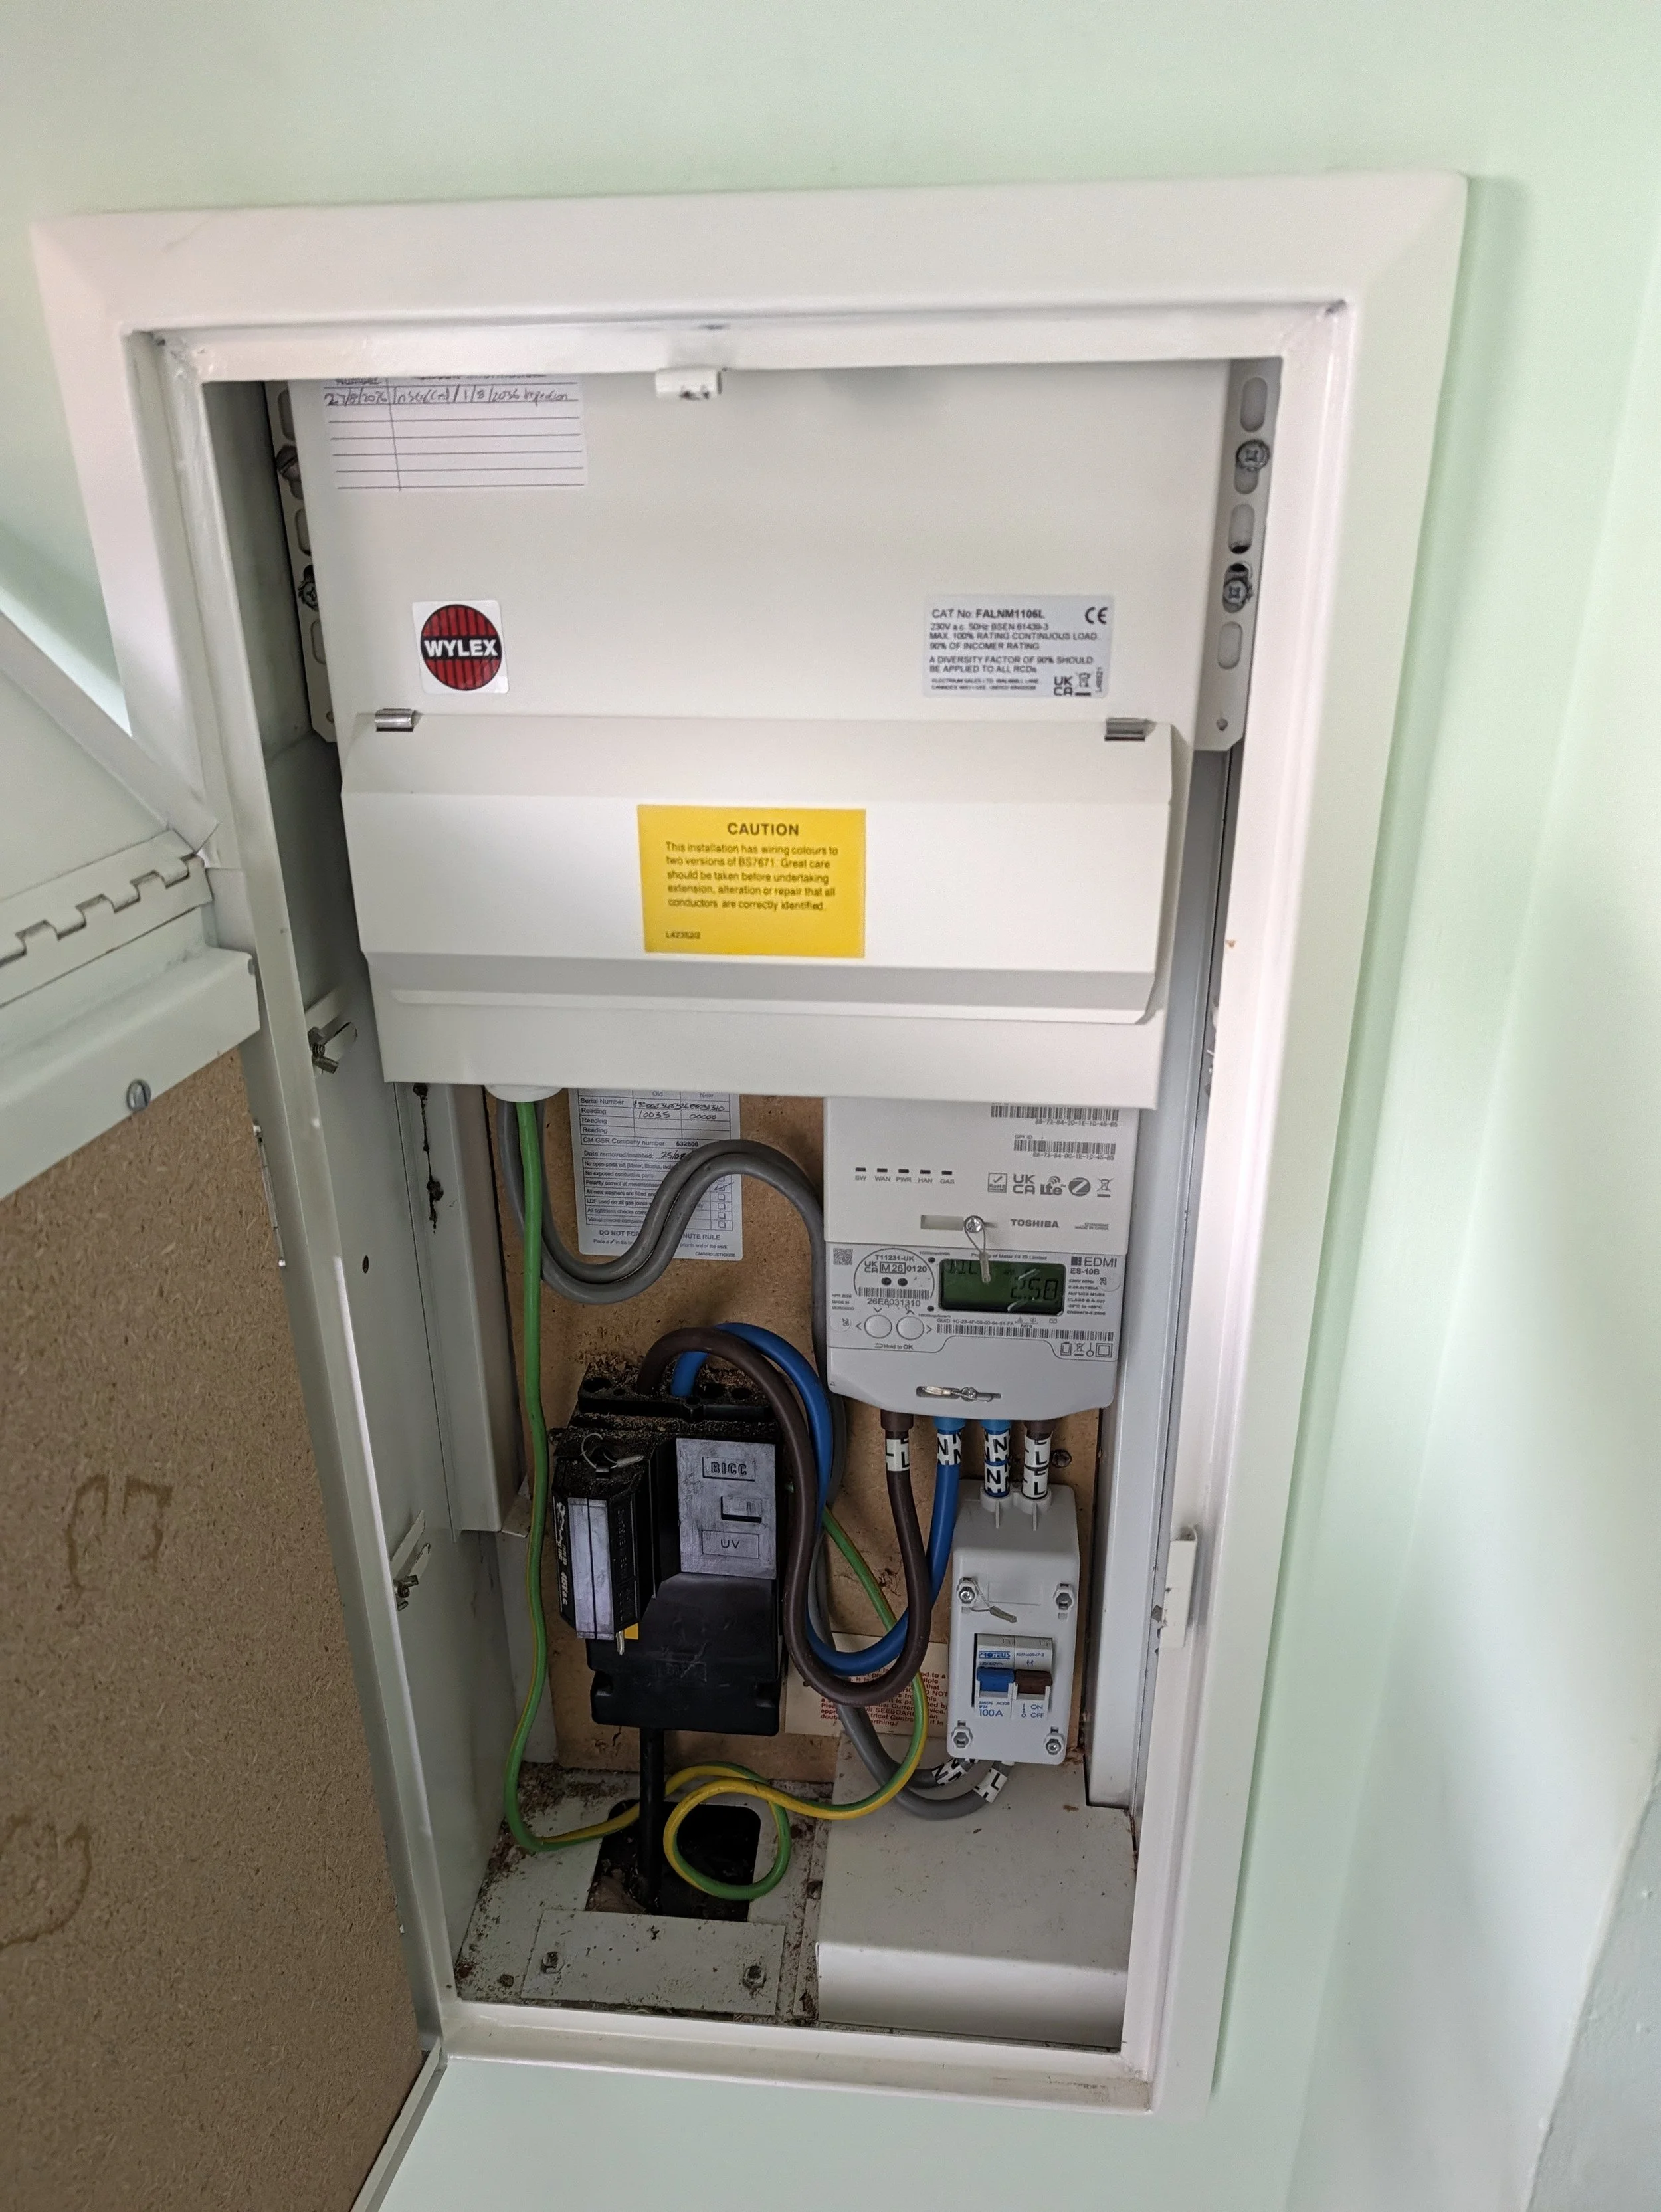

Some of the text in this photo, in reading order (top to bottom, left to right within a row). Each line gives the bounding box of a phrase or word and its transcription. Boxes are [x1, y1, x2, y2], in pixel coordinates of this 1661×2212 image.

[932, 608, 1045, 619] CAT FALNM1106L
[424, 639, 498, 657] WYLEX
[1007, 642, 1040, 651] RATING
[937, 655, 983, 664] DIVERSITY
[985, 655, 1021, 664] FACTOR
[1056, 655, 1094, 664] SHOULD
[1054, 676, 1073, 686] UK
[1054, 686, 1073, 696] CA
[728, 823, 799, 835] CAUTION
[666, 841, 838, 857] This installation has wiring colours to
[666, 855, 684, 865] two
[685, 857, 726, 866] versions
[726, 857, 736, 867] of
[780, 857, 807, 868] Great
[809, 860, 830, 869] care
[667, 870, 829, 886] should be taken before undertaking
[718, 884, 761, 896] alteration
[763, 887, 772, 896] or
[775, 887, 802, 898] repair
[804, 886, 823, 896] that
[825, 886, 836, 897] all
[668, 898, 718, 908] conductors
[722, 900, 736, 909] are
[738, 900, 779, 912] correctly
[582, 1126, 608, 1135] Reading
[611, 1138, 641, 1147] Company
[1013, 1173, 1036, 1185] UK
[1012, 1184, 1036, 1195] CA
[1010, 1218, 1060, 1229] TOSHIBA
[1084, 1257, 1118, 1268] EDMI
[867, 1296, 922, 1308] 26E8031310
[711, 1461, 747, 1476] BICC
[987, 1468, 1001, 1485] N
[720, 1538, 740, 1550] UV
[978, 1651, 1011, 1659] PROTEUS
